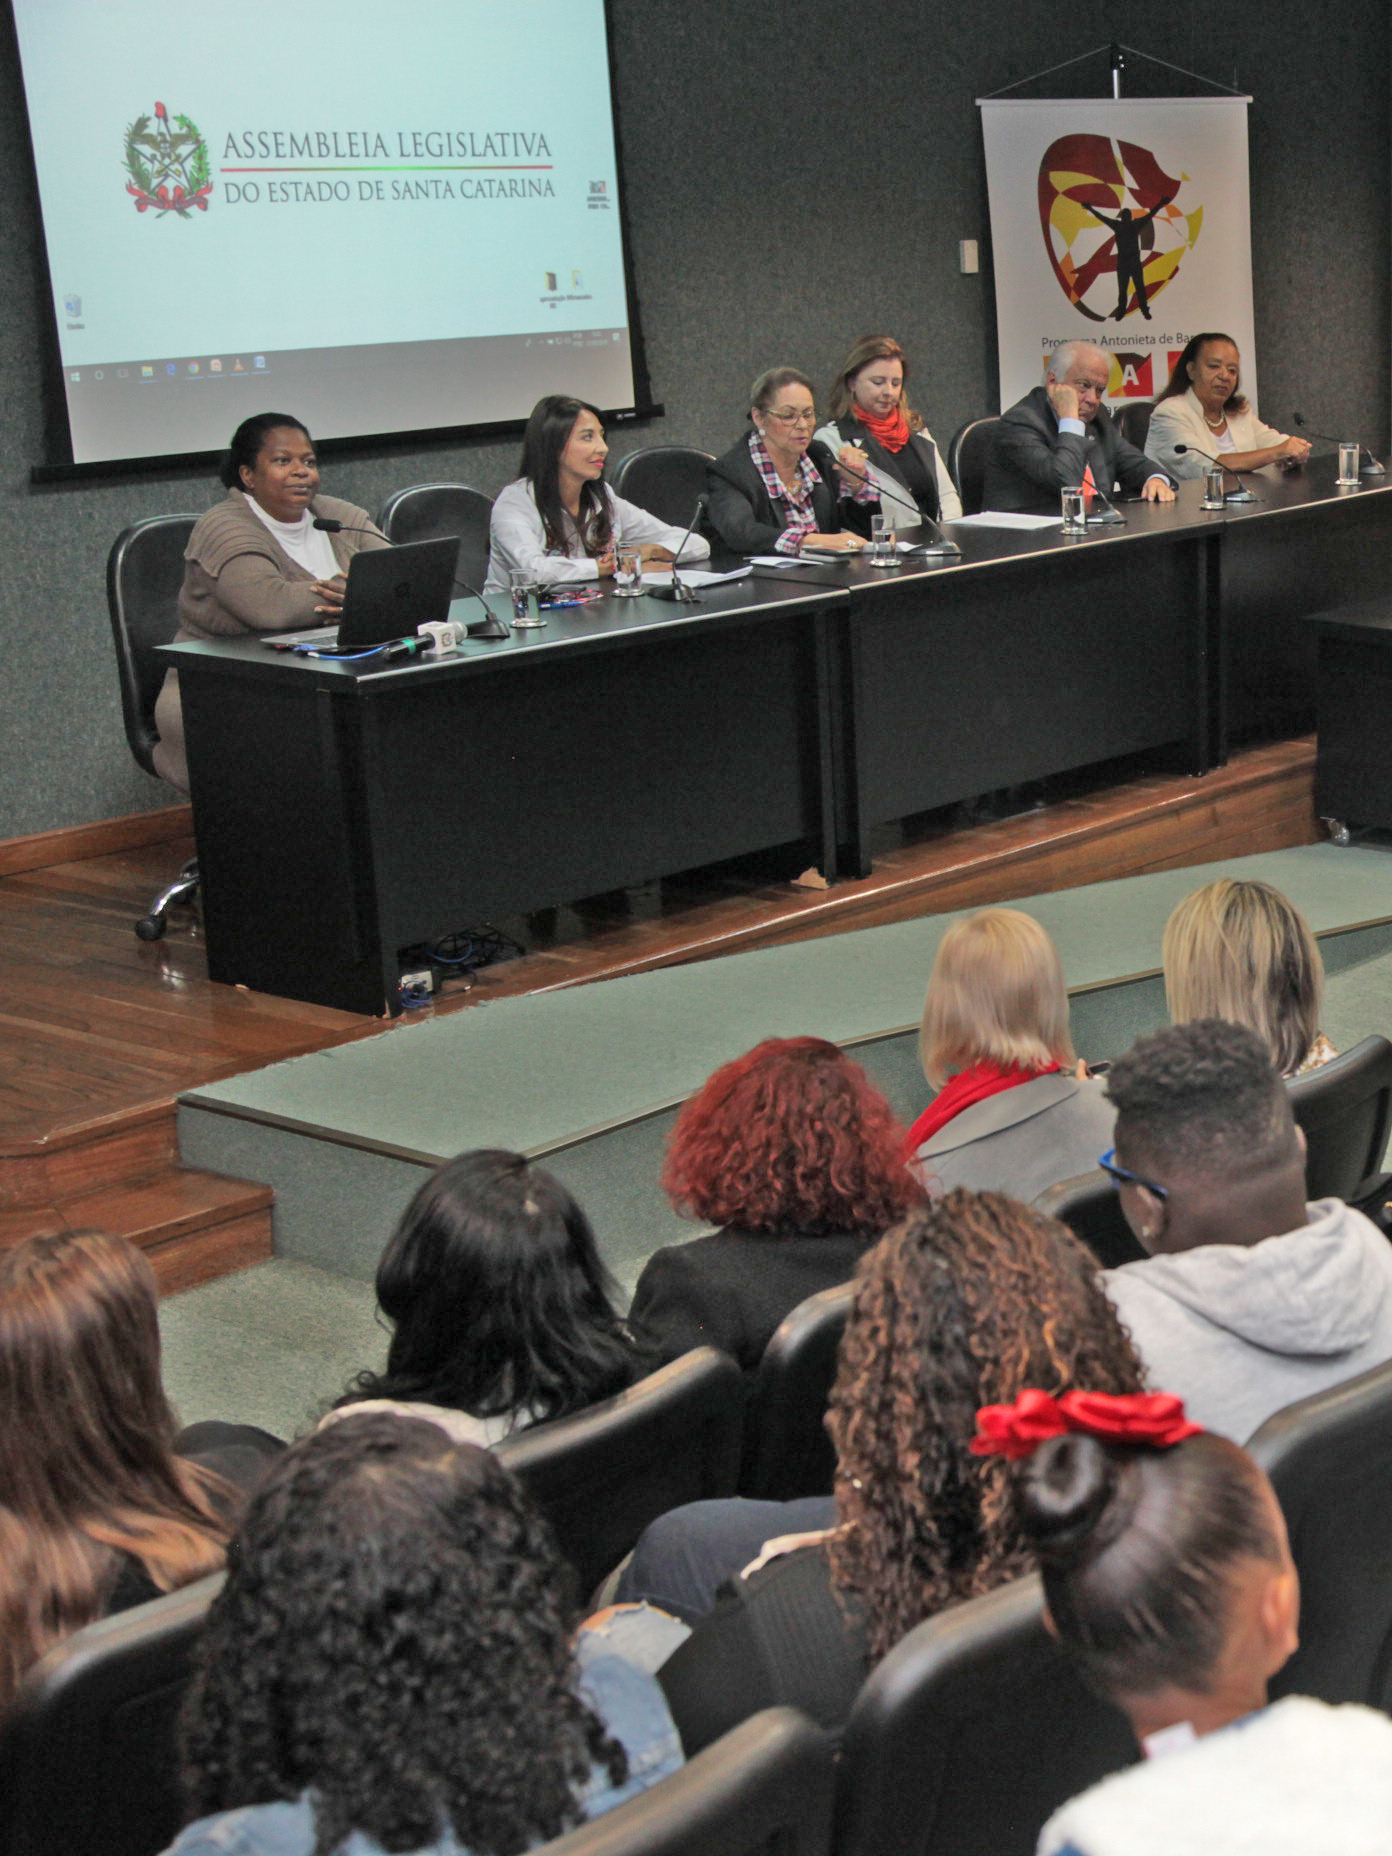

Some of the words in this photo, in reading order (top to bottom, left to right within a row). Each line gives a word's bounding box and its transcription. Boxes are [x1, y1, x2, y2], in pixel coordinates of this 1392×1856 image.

[222, 131, 390, 159] ASSEMBLEIA
[397, 131, 553, 158] LEGISLATIVA
[224, 181, 260, 204] DO
[267, 180, 350, 203] ESTADO
[357, 180, 386, 202] DE
[391, 179, 456, 201] SANTA
[460, 178, 556, 199] CATARINA
[1041, 337, 1098, 349] Proa
[1100, 334, 1156, 347] Antonieta
[1159, 333, 1174, 344] de
[1176, 332, 1197, 344] Bar
[1122, 364, 1139, 385] A
